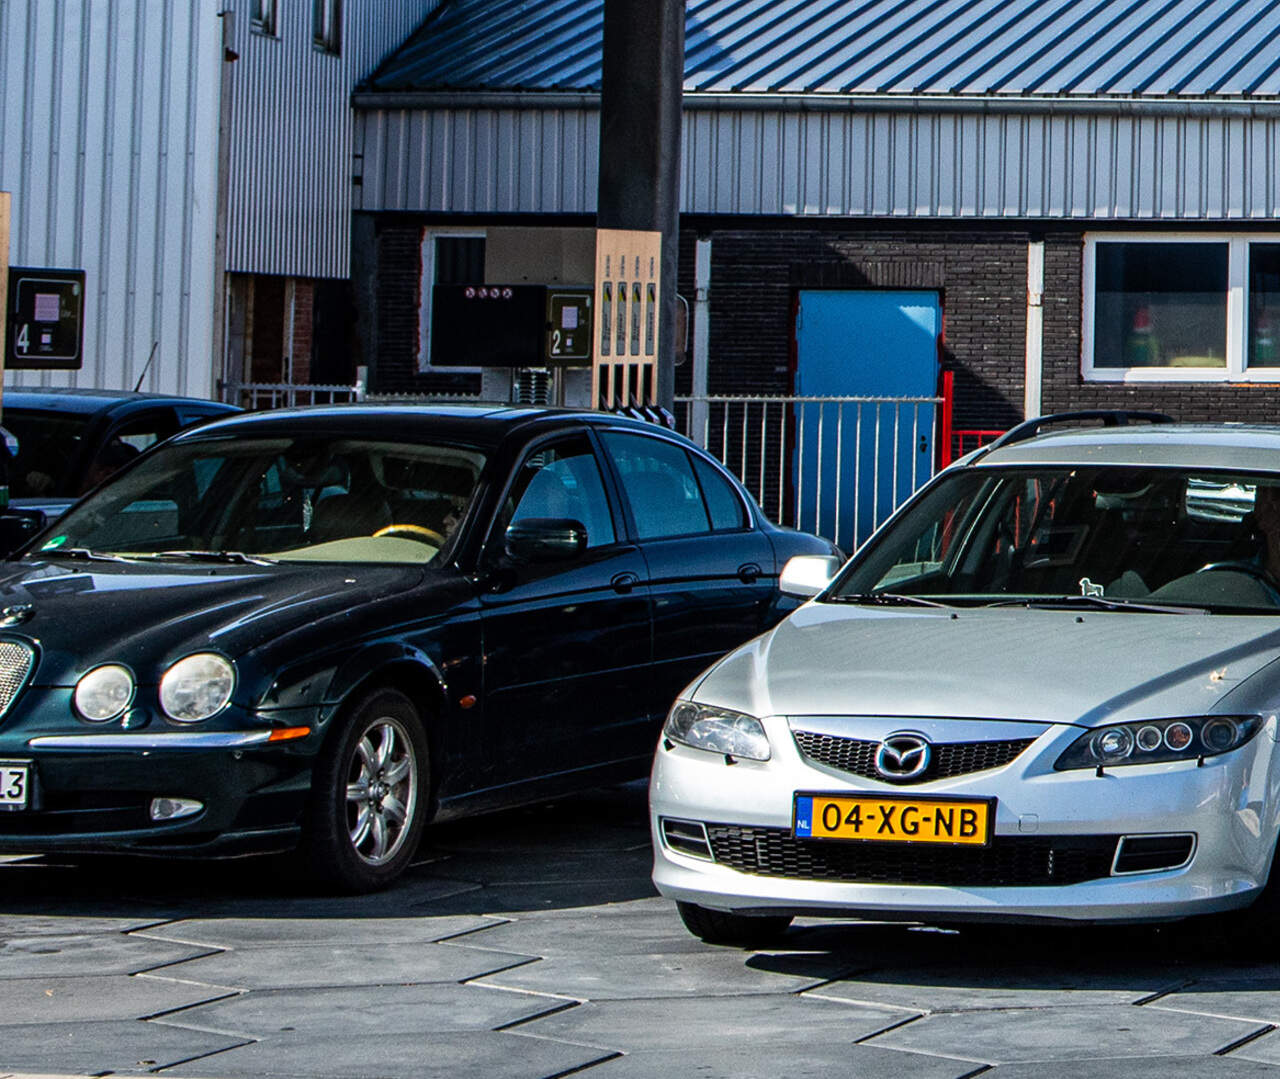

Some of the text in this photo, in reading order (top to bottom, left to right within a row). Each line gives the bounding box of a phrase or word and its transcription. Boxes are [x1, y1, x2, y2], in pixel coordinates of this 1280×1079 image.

[17, 323, 30, 354] 4
[552, 330, 561, 354] 2
[797, 803, 979, 837] NL 04-XG-NB
